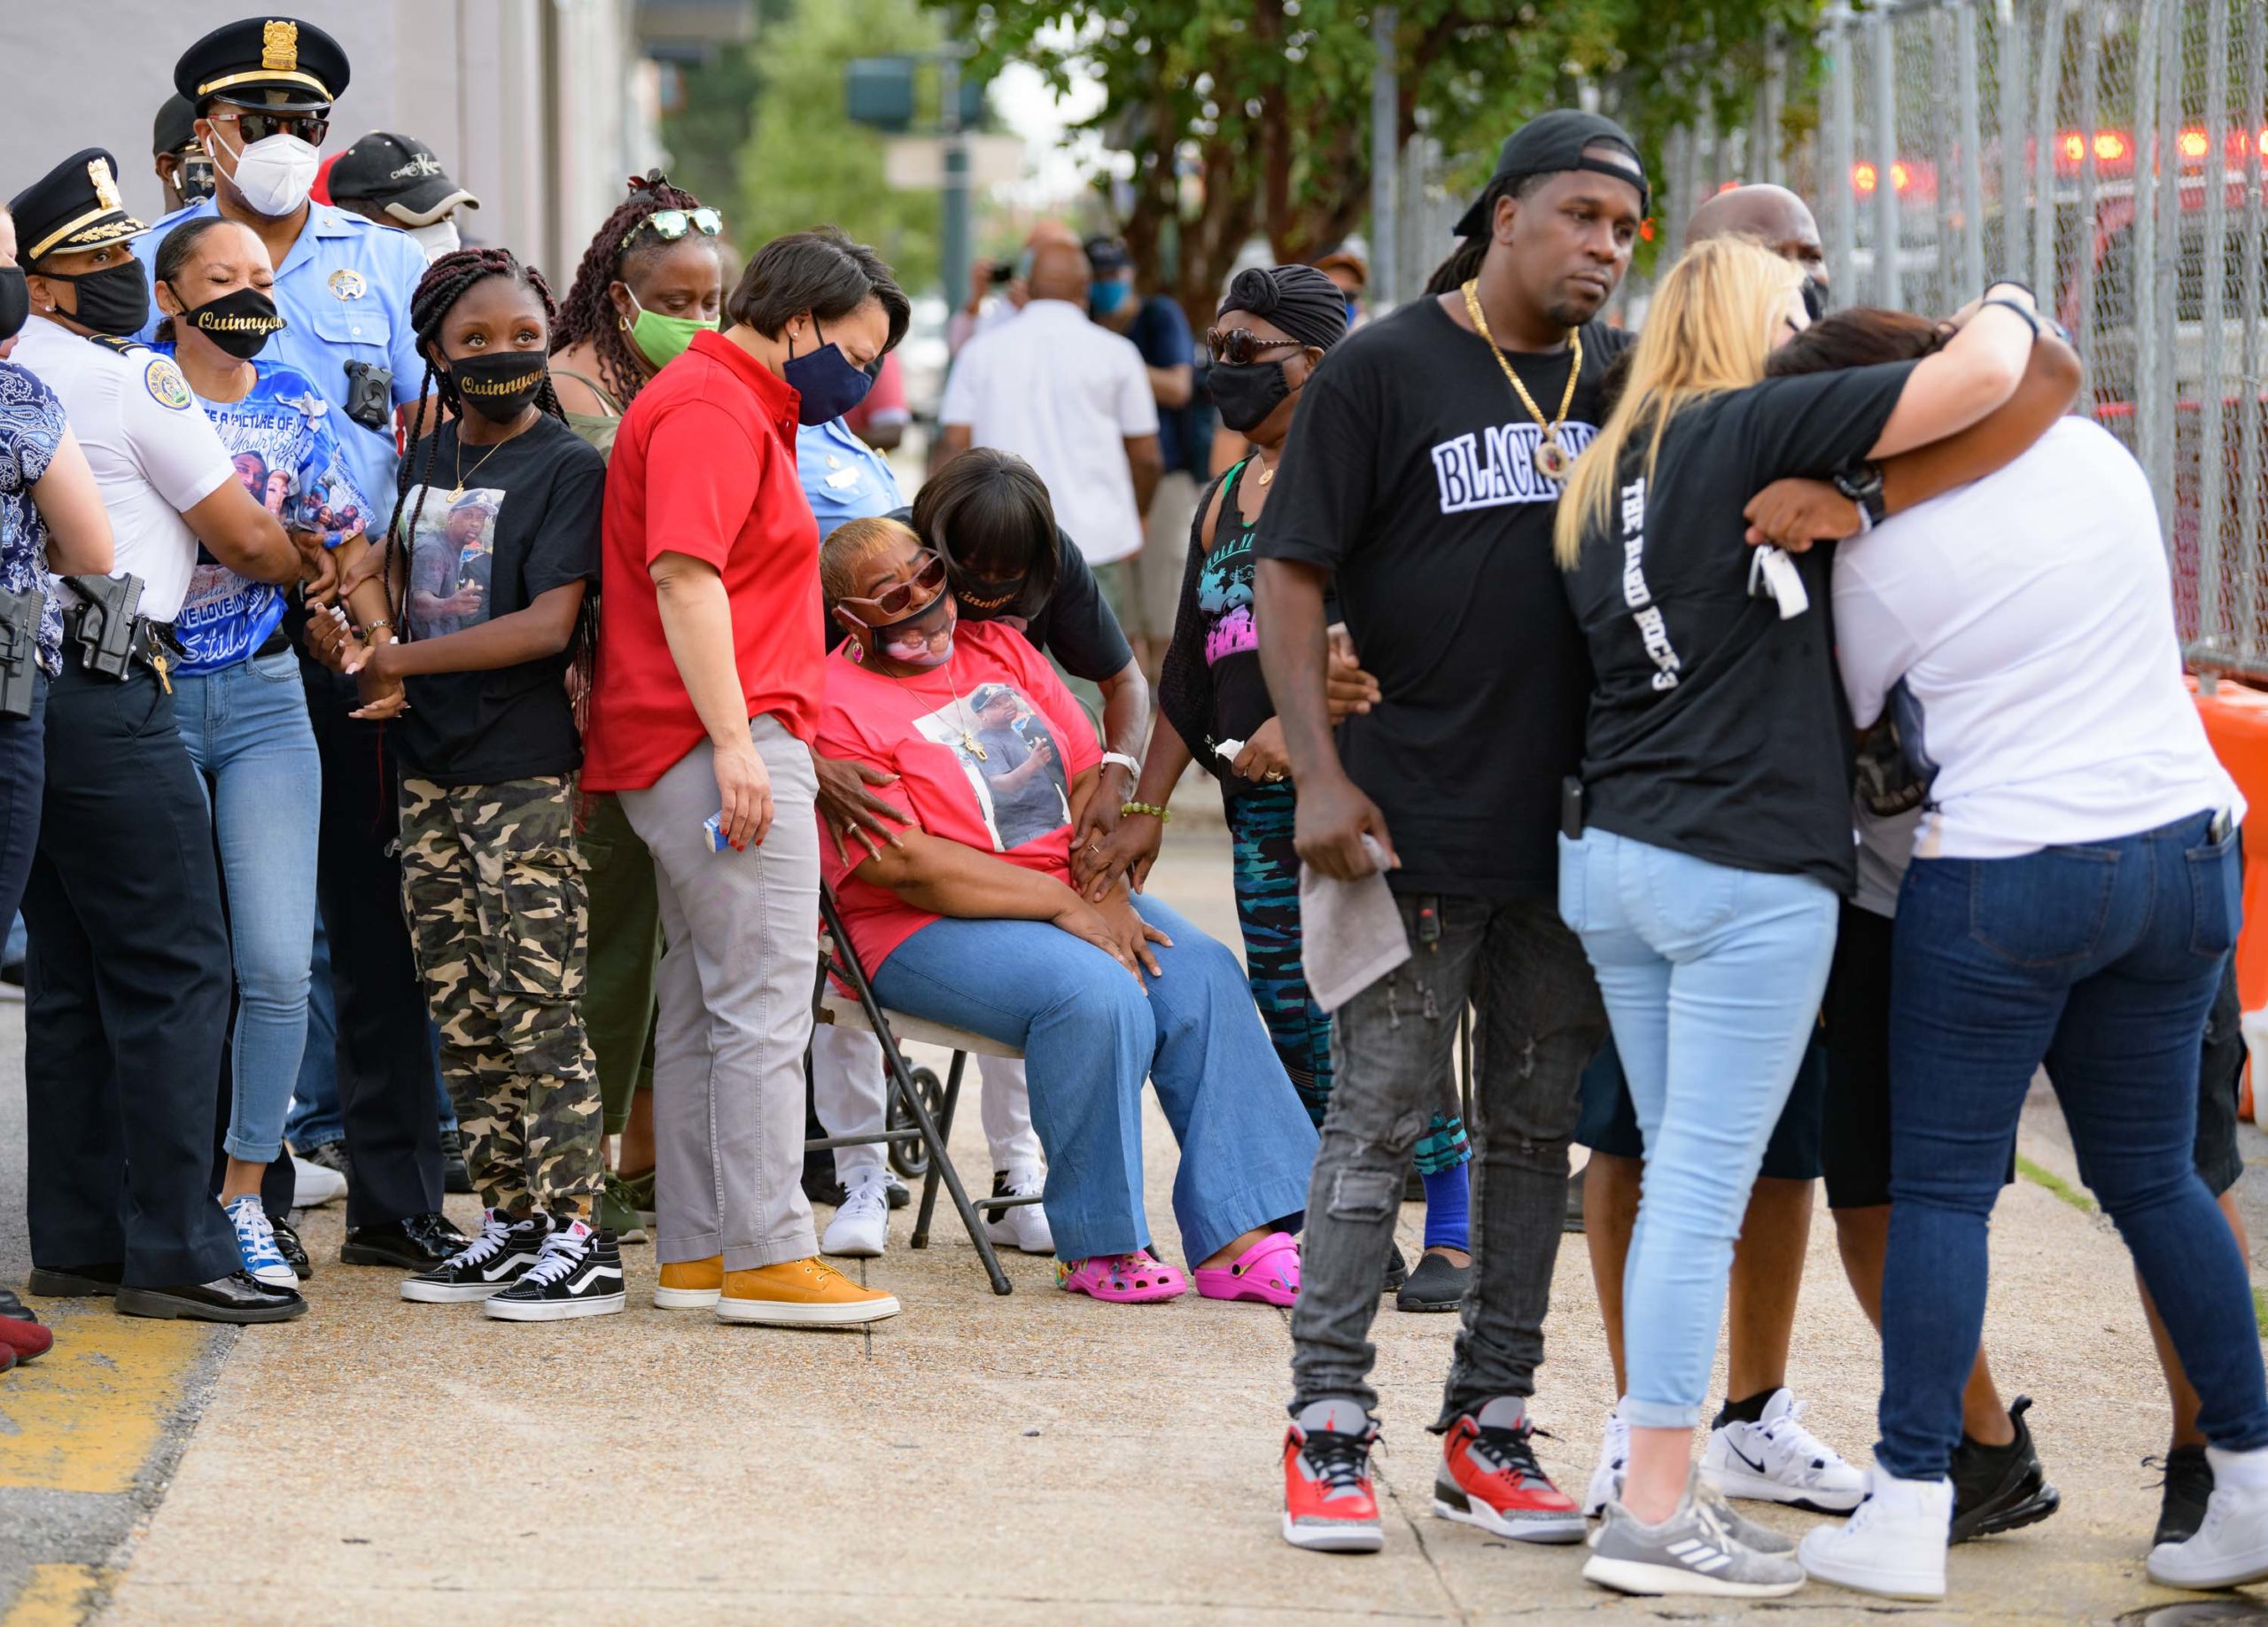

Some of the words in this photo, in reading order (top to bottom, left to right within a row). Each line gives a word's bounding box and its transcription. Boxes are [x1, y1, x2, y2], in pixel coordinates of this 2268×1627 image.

[462, 369, 543, 395] Quinnyon
[220, 412, 229, 424] A
[277, 416, 293, 431] OF
[1621, 477, 1645, 535] THE
[1623, 534, 1651, 608] HARD
[198, 598, 230, 621] LOVE
[182, 618, 249, 665] Still
